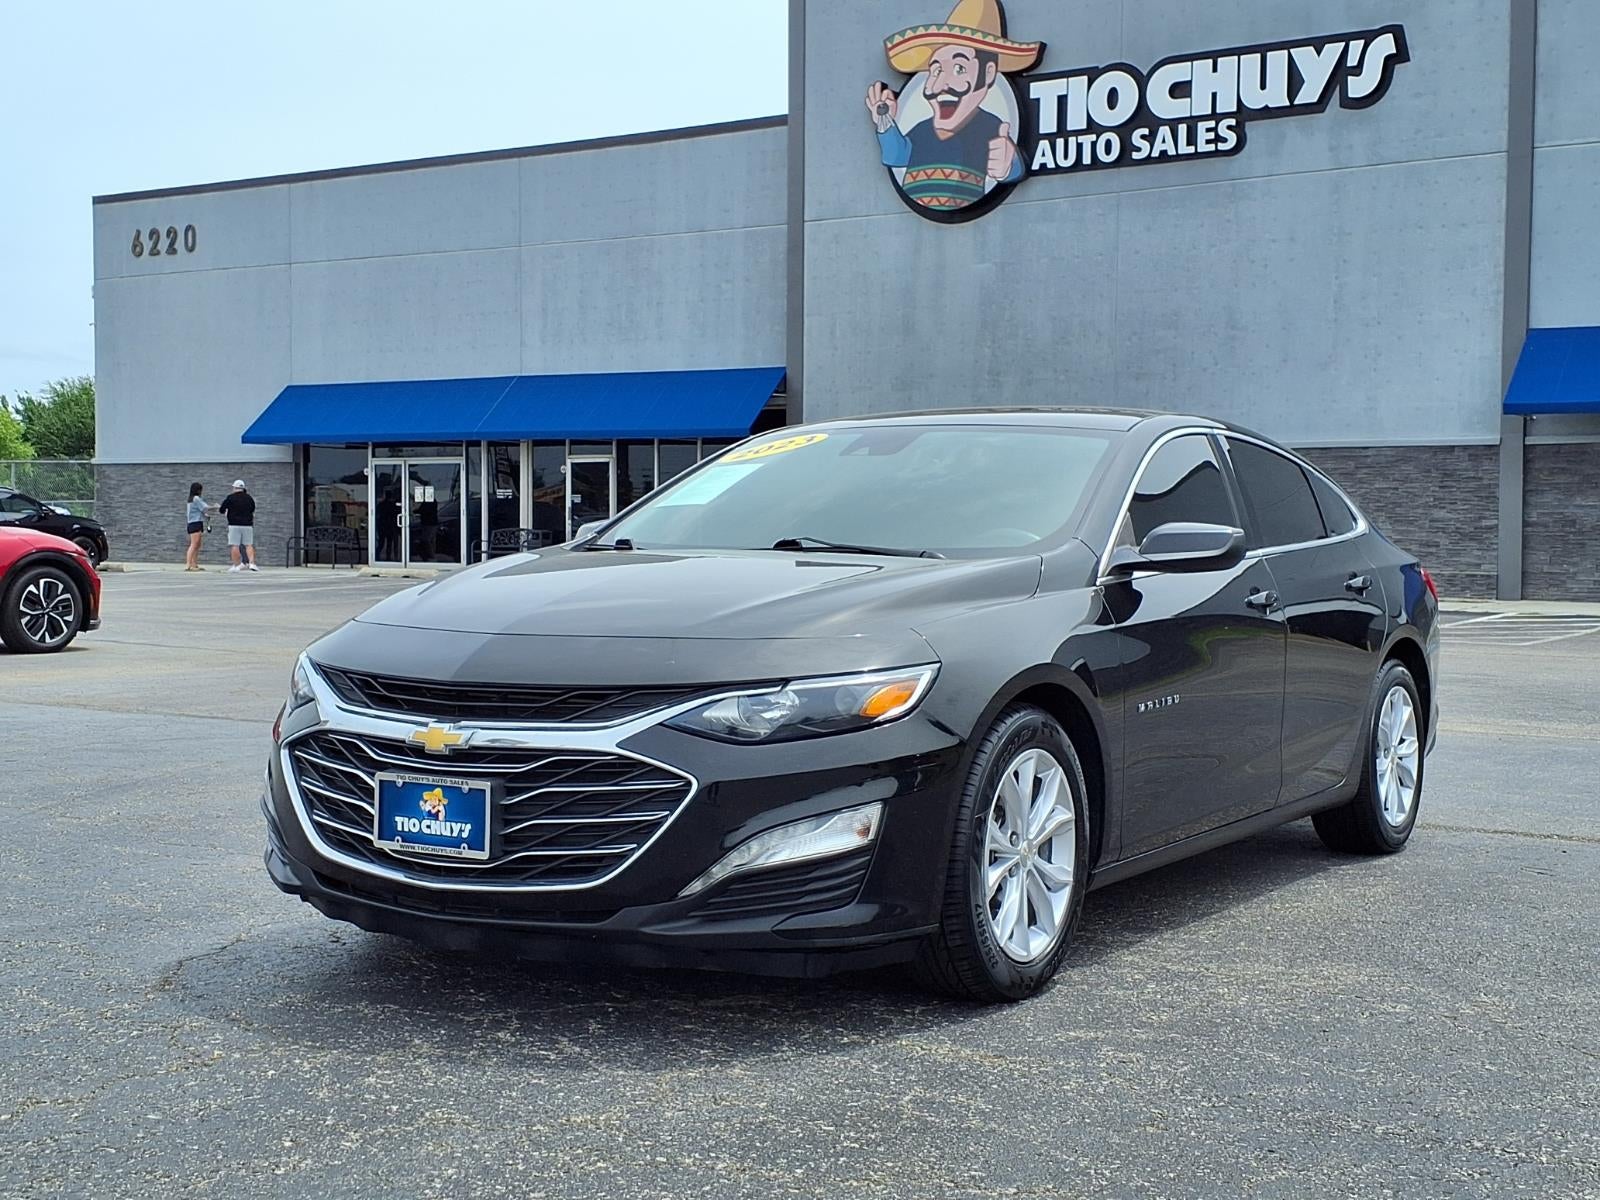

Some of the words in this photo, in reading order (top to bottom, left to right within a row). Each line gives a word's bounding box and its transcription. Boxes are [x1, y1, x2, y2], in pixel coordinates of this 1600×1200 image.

[1030, 70, 1139, 135] TIO
[1146, 32, 1397, 118] CHUY'S
[1031, 131, 1120, 171] AUTO
[1131, 118, 1238, 160] SALES
[131, 224, 196, 257] 6220
[1138, 694, 1180, 713] MALIBU
[432, 777, 448, 785] AUTO
[450, 779, 469, 787] SALES
[395, 816, 420, 833] TIO
[421, 819, 471, 838] CHUY'S
